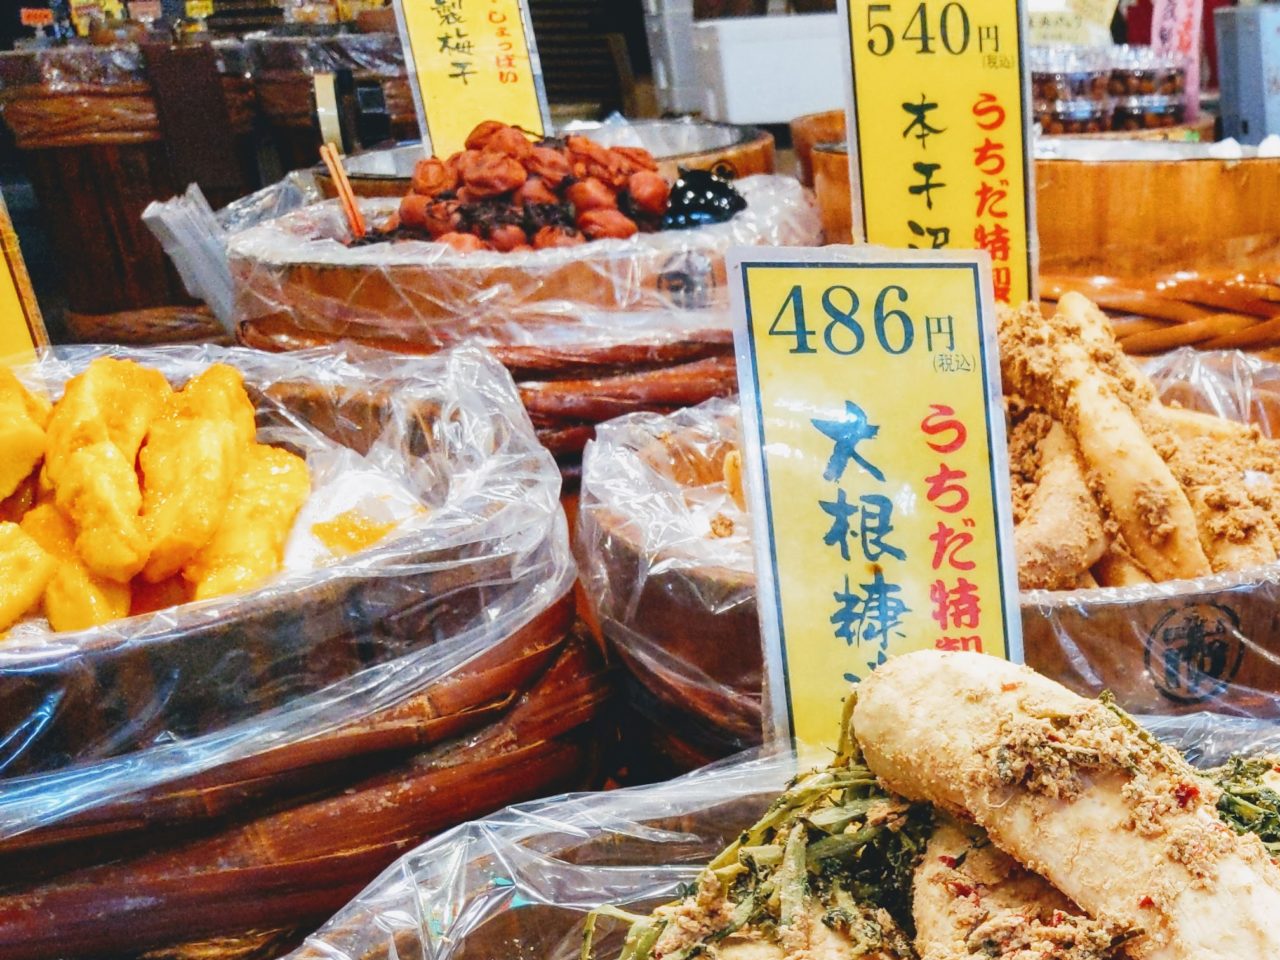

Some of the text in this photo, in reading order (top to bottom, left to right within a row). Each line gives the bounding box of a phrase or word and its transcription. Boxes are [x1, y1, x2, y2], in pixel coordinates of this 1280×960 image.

[867, 2, 1000, 56] 540円
[768, 284, 956, 355] 486円
[932, 354, 976, 373] (税込)
[810, 400, 913, 702] 大根糠
